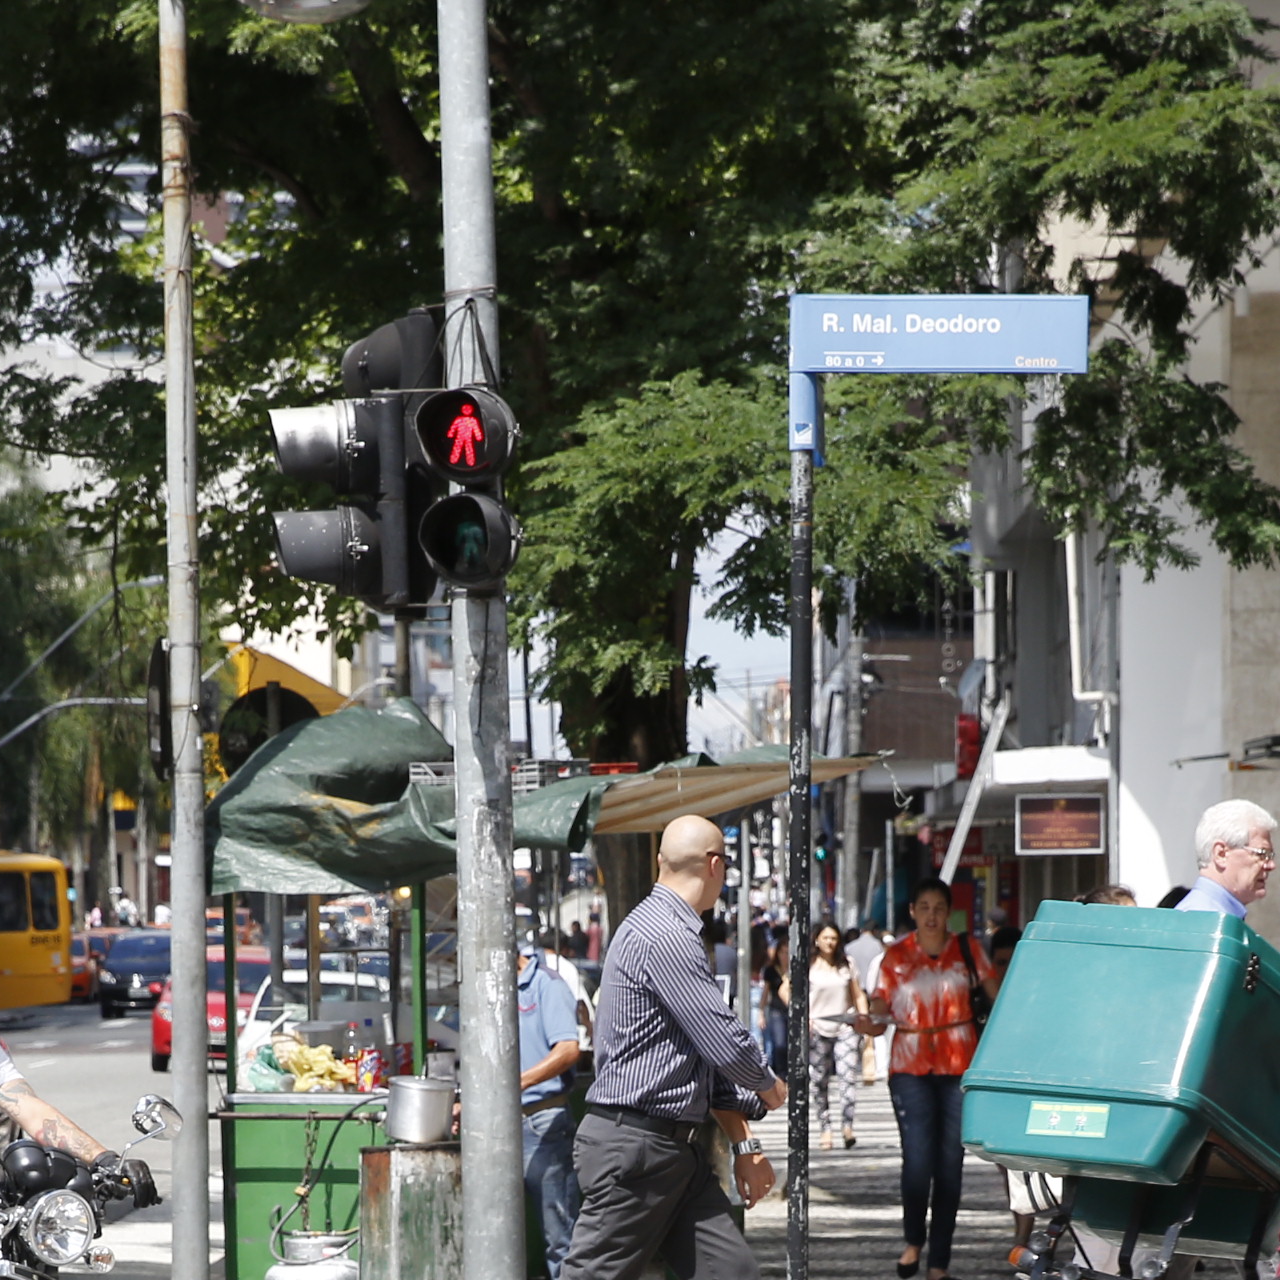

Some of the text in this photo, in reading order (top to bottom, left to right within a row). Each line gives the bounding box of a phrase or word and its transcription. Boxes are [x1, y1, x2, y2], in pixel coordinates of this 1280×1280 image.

[822, 313, 1001, 334] R. Mal. Deodoro
[825, 356, 842, 367] 80
[844, 358, 853, 367] a
[1015, 355, 1058, 368] Centro
